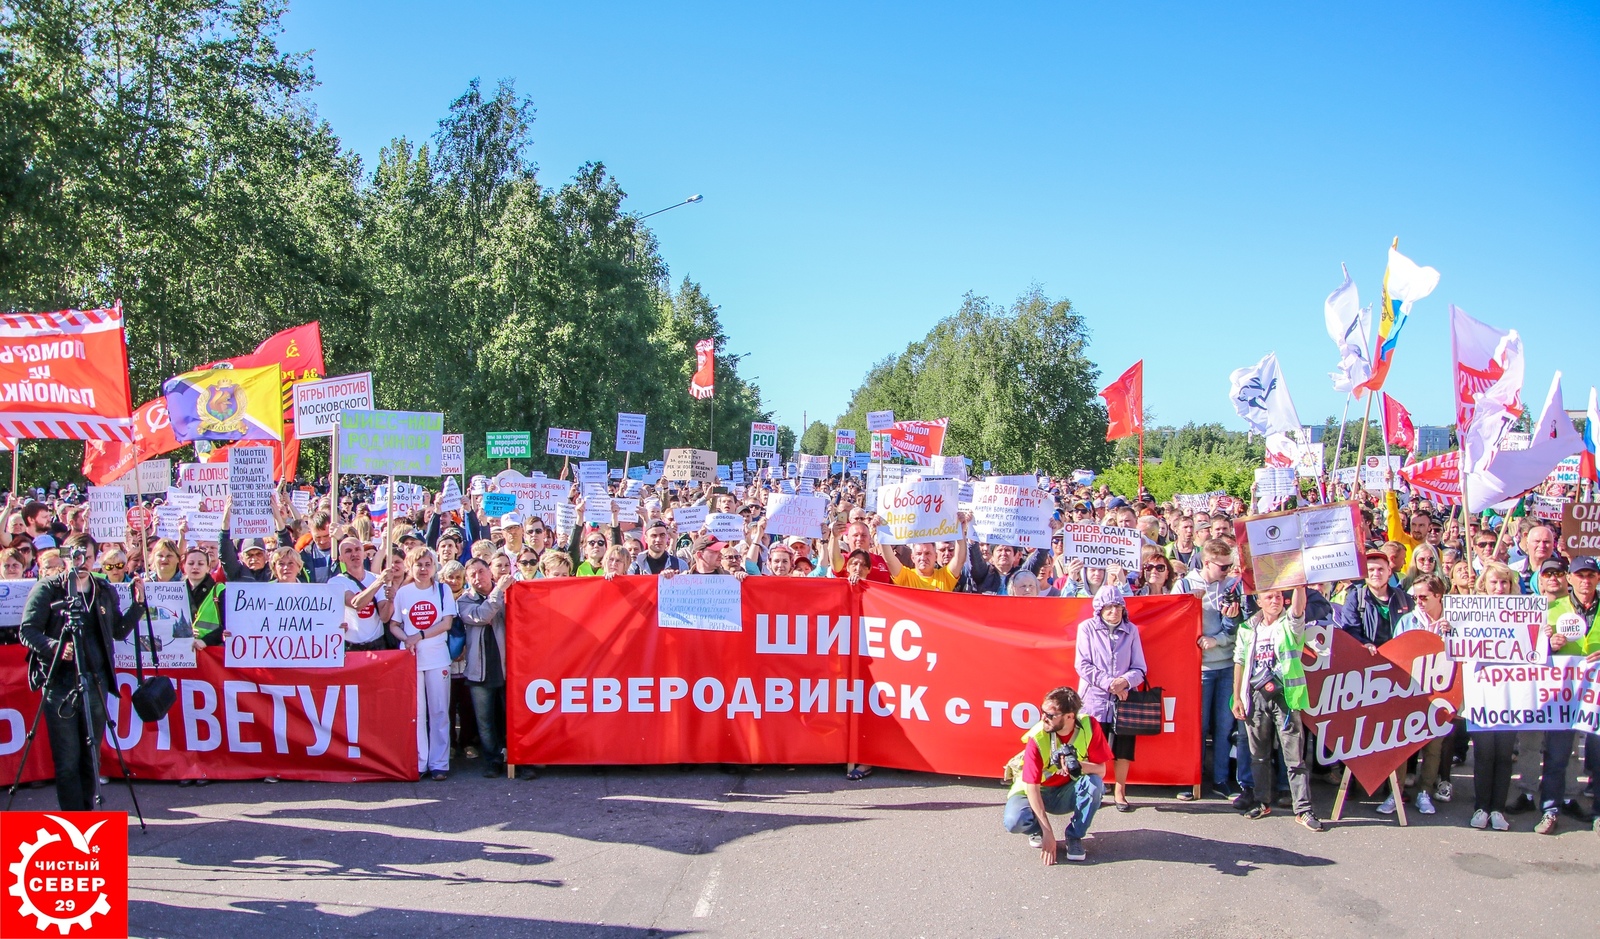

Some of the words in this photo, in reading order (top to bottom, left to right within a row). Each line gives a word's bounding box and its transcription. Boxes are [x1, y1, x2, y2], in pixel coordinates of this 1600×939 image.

[299, 389, 326, 403] ЯГРЫ
[327, 381, 367, 400] ПРОТИВ
[299, 396, 368, 416] МОСКОВСКОГО
[348, 432, 430, 452] РОДИНОЙ
[560, 431, 580, 439] НЕТ
[752, 434, 775, 447] РСО
[491, 446, 526, 456] мусора
[751, 451, 774, 459] СМЕРТИ
[234, 457, 268, 465] ЗАЩИТИЛ!
[341, 454, 358, 469] НЕ
[183, 469, 195, 481] НЕ
[230, 474, 269, 483] СОХРАНИТЬ!
[994, 484, 1018, 495] ВЗЯЛИ
[1019, 488, 1029, 497] НА
[1031, 489, 1049, 500] СЕБЯ
[883, 487, 945, 513] Свободу
[90, 517, 124, 525] МУСОРА
[882, 511, 916, 526] Анне
[234, 527, 242, 535] НЕ
[243, 526, 271, 535] ТОРГУЮ!
[895, 519, 959, 540] Шекаловой!
[1103, 526, 1126, 537] САМ
[1128, 529, 1142, 539] ТЫ
[1072, 533, 1136, 547] ШЕЛУПОНЬ.
[1075, 544, 1126, 557] ПОМОРЬЕ
[414, 603, 431, 611] НЕТ!
[1506, 595, 1548, 612] СТРОЙКУ
[260, 616, 270, 632] А
[1445, 611, 1496, 622] ПОЛИГОНА
[1499, 610, 1543, 623] СМЕРТИ
[1464, 627, 1516, 639] БОЛОТАХ
[231, 634, 343, 660] ОТХОДЫ?
[756, 613, 938, 672] ШИЕС,
[1477, 666, 1600, 687] Архангельс
[525, 676, 930, 722] СЕВЕРОДВИНСК
[1539, 687, 1572, 702] это
[1470, 704, 1552, 724] Москва!
